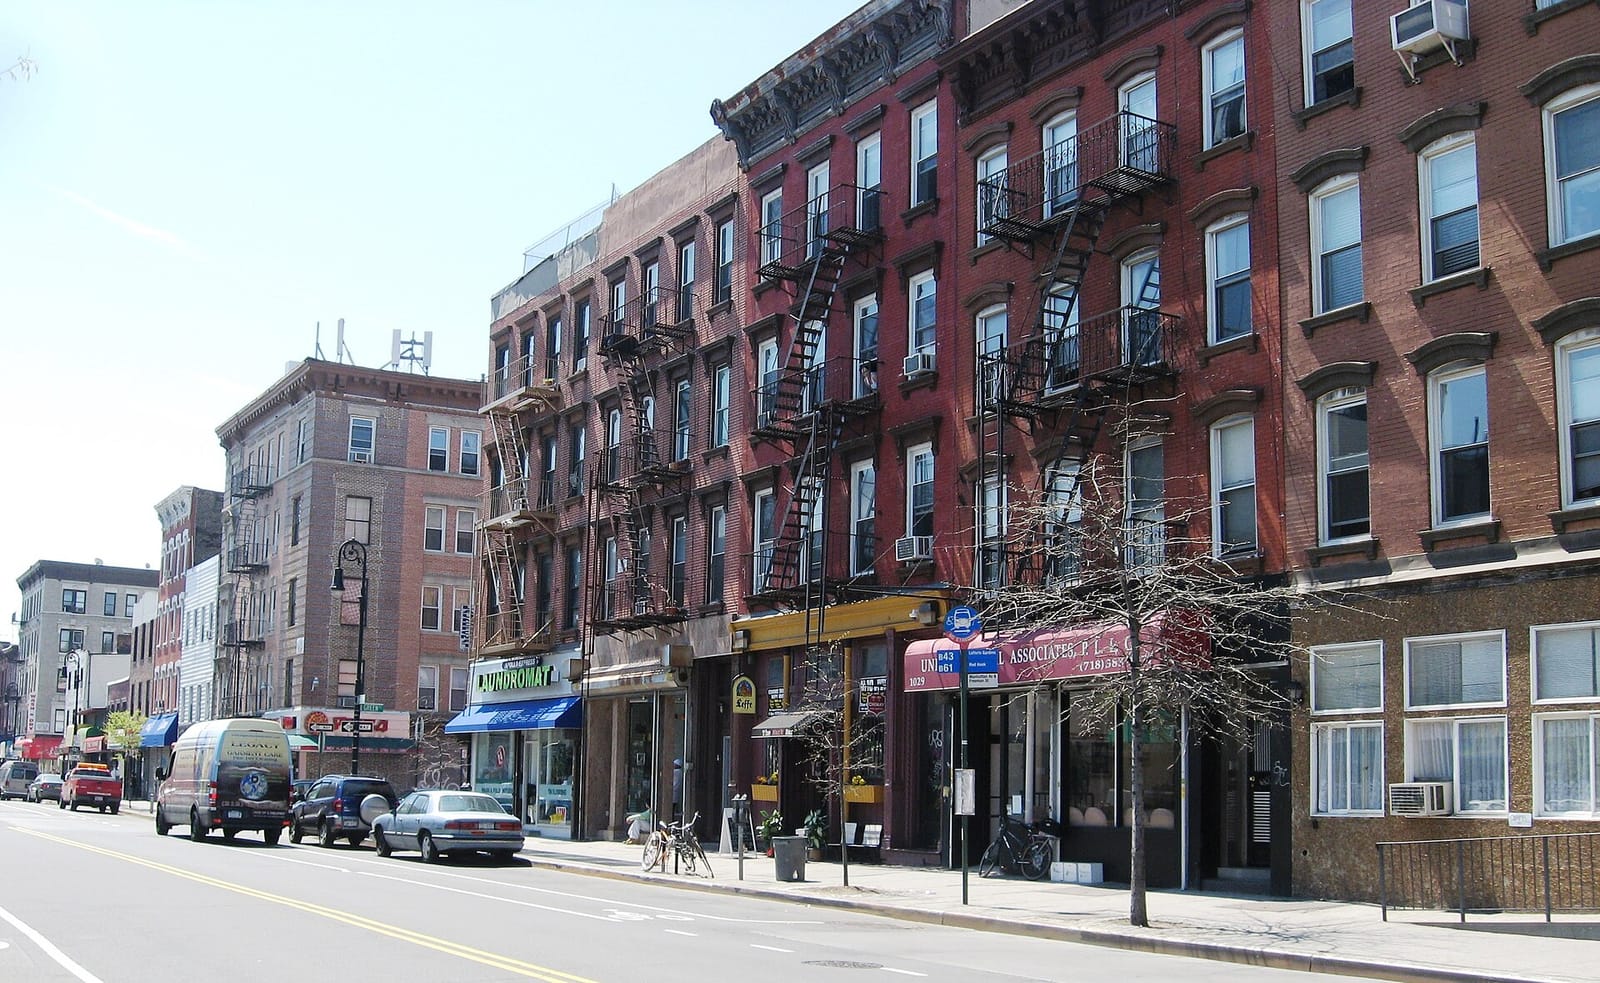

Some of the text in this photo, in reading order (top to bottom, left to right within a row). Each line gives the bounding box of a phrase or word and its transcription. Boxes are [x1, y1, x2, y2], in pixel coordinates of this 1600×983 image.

[476, 665, 551, 692] LAUNDROMAT
[909, 677, 925, 687] 1029
[735, 698, 752, 709] Leffe
